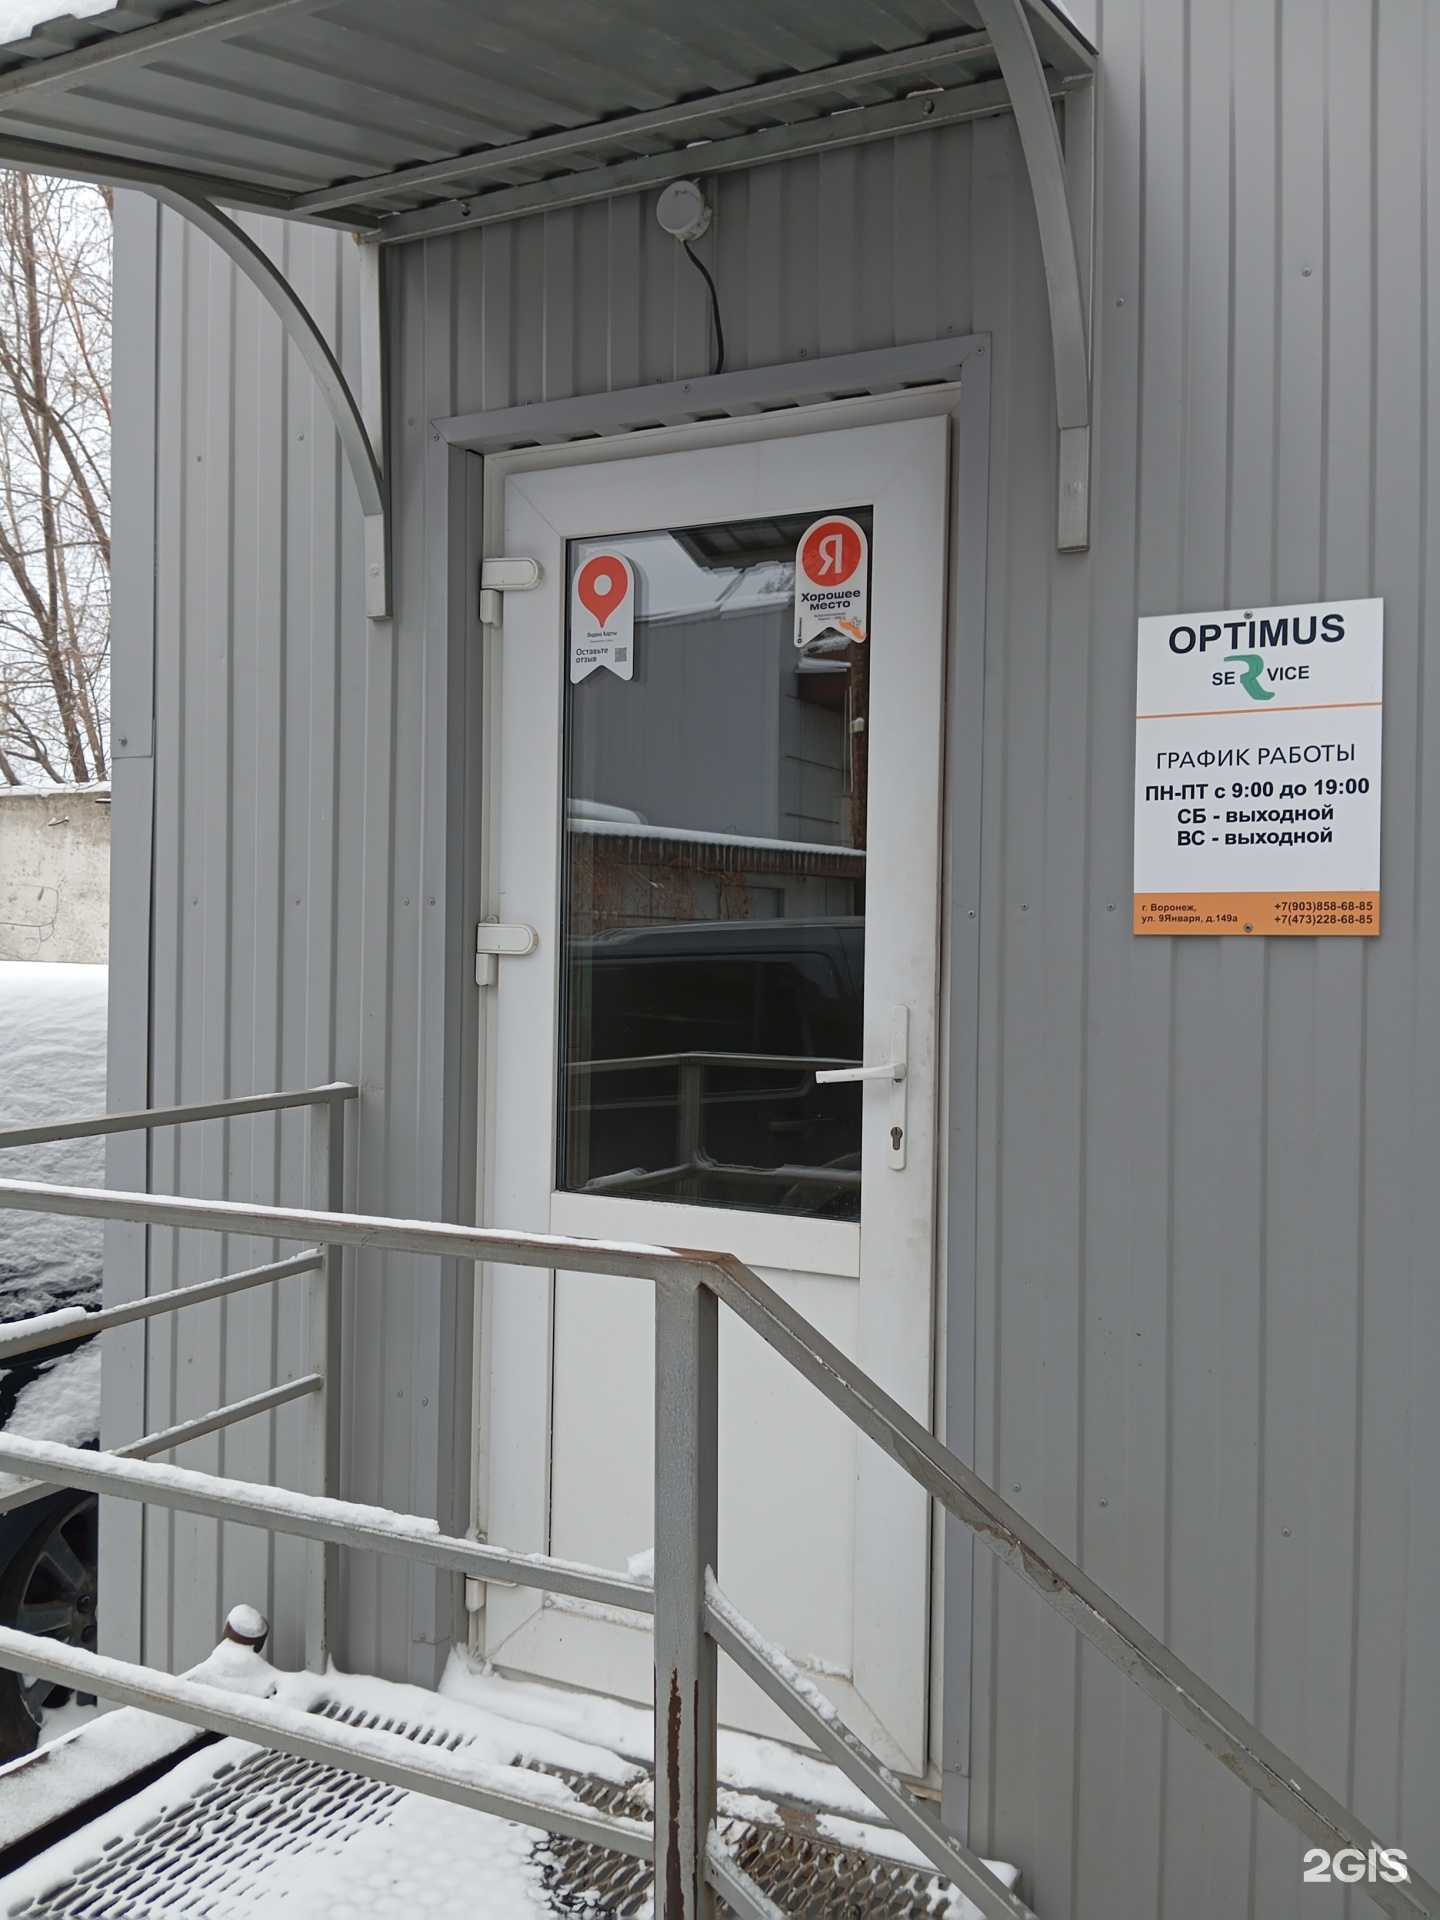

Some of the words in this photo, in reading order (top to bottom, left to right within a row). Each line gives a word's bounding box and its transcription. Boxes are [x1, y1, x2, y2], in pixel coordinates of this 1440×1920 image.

[818, 534, 843, 576] Я
[801, 590, 861, 602] Хорошее
[809, 600, 851, 611] место
[1169, 614, 1345, 654] OPTIMUS
[1157, 748, 1250, 769] ГРАФИК
[1258, 744, 1355, 765] РАБОТЫ
[1145, 783, 1208, 801] ПН-ПТ
[1214, 786, 1226, 799] с
[1231, 781, 1274, 798] 9:00
[1279, 784, 1307, 799] до
[1314, 778, 1370, 795] 19:00
[1177, 808, 1206, 824] СБ
[1226, 804, 1334, 824] выходной
[1177, 830, 1205, 846] ВС
[1225, 827, 1333, 847] выходной
[1150, 903, 1197, 913] Воронеж,
[1274, 901, 1373, 913] +7(903)858-68-85
[1274, 914, 1373, 926] +7(473)228-68-85
